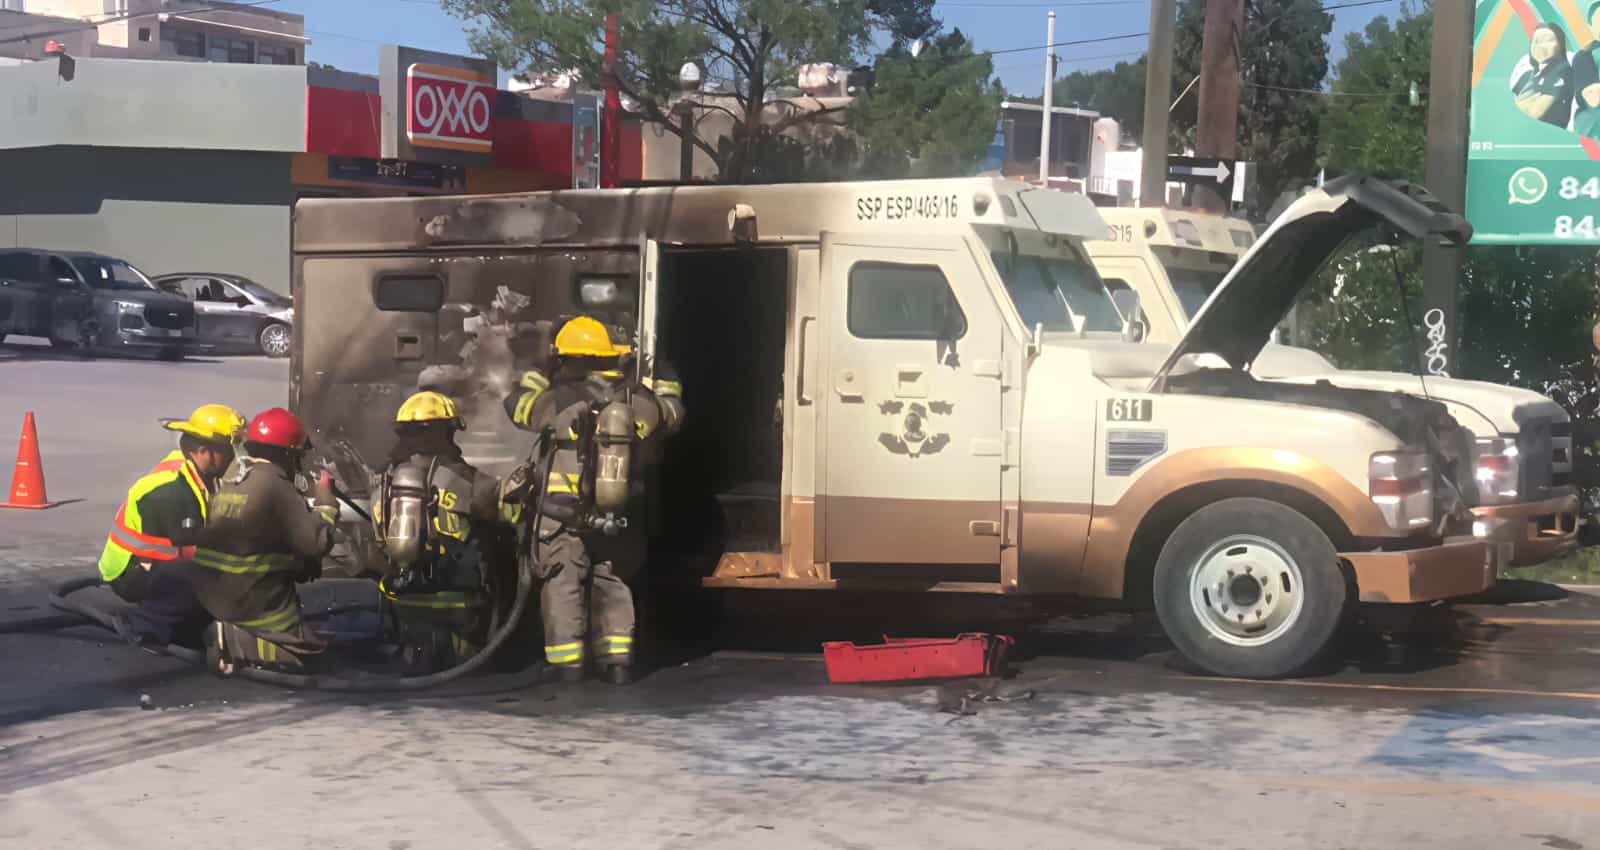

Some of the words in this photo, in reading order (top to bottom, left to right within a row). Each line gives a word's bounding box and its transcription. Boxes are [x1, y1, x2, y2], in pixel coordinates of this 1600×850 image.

[415, 84, 489, 135] OXXO
[857, 197, 882, 220] SSP
[1554, 215, 1600, 239] 84
[1111, 399, 1143, 420] 611
